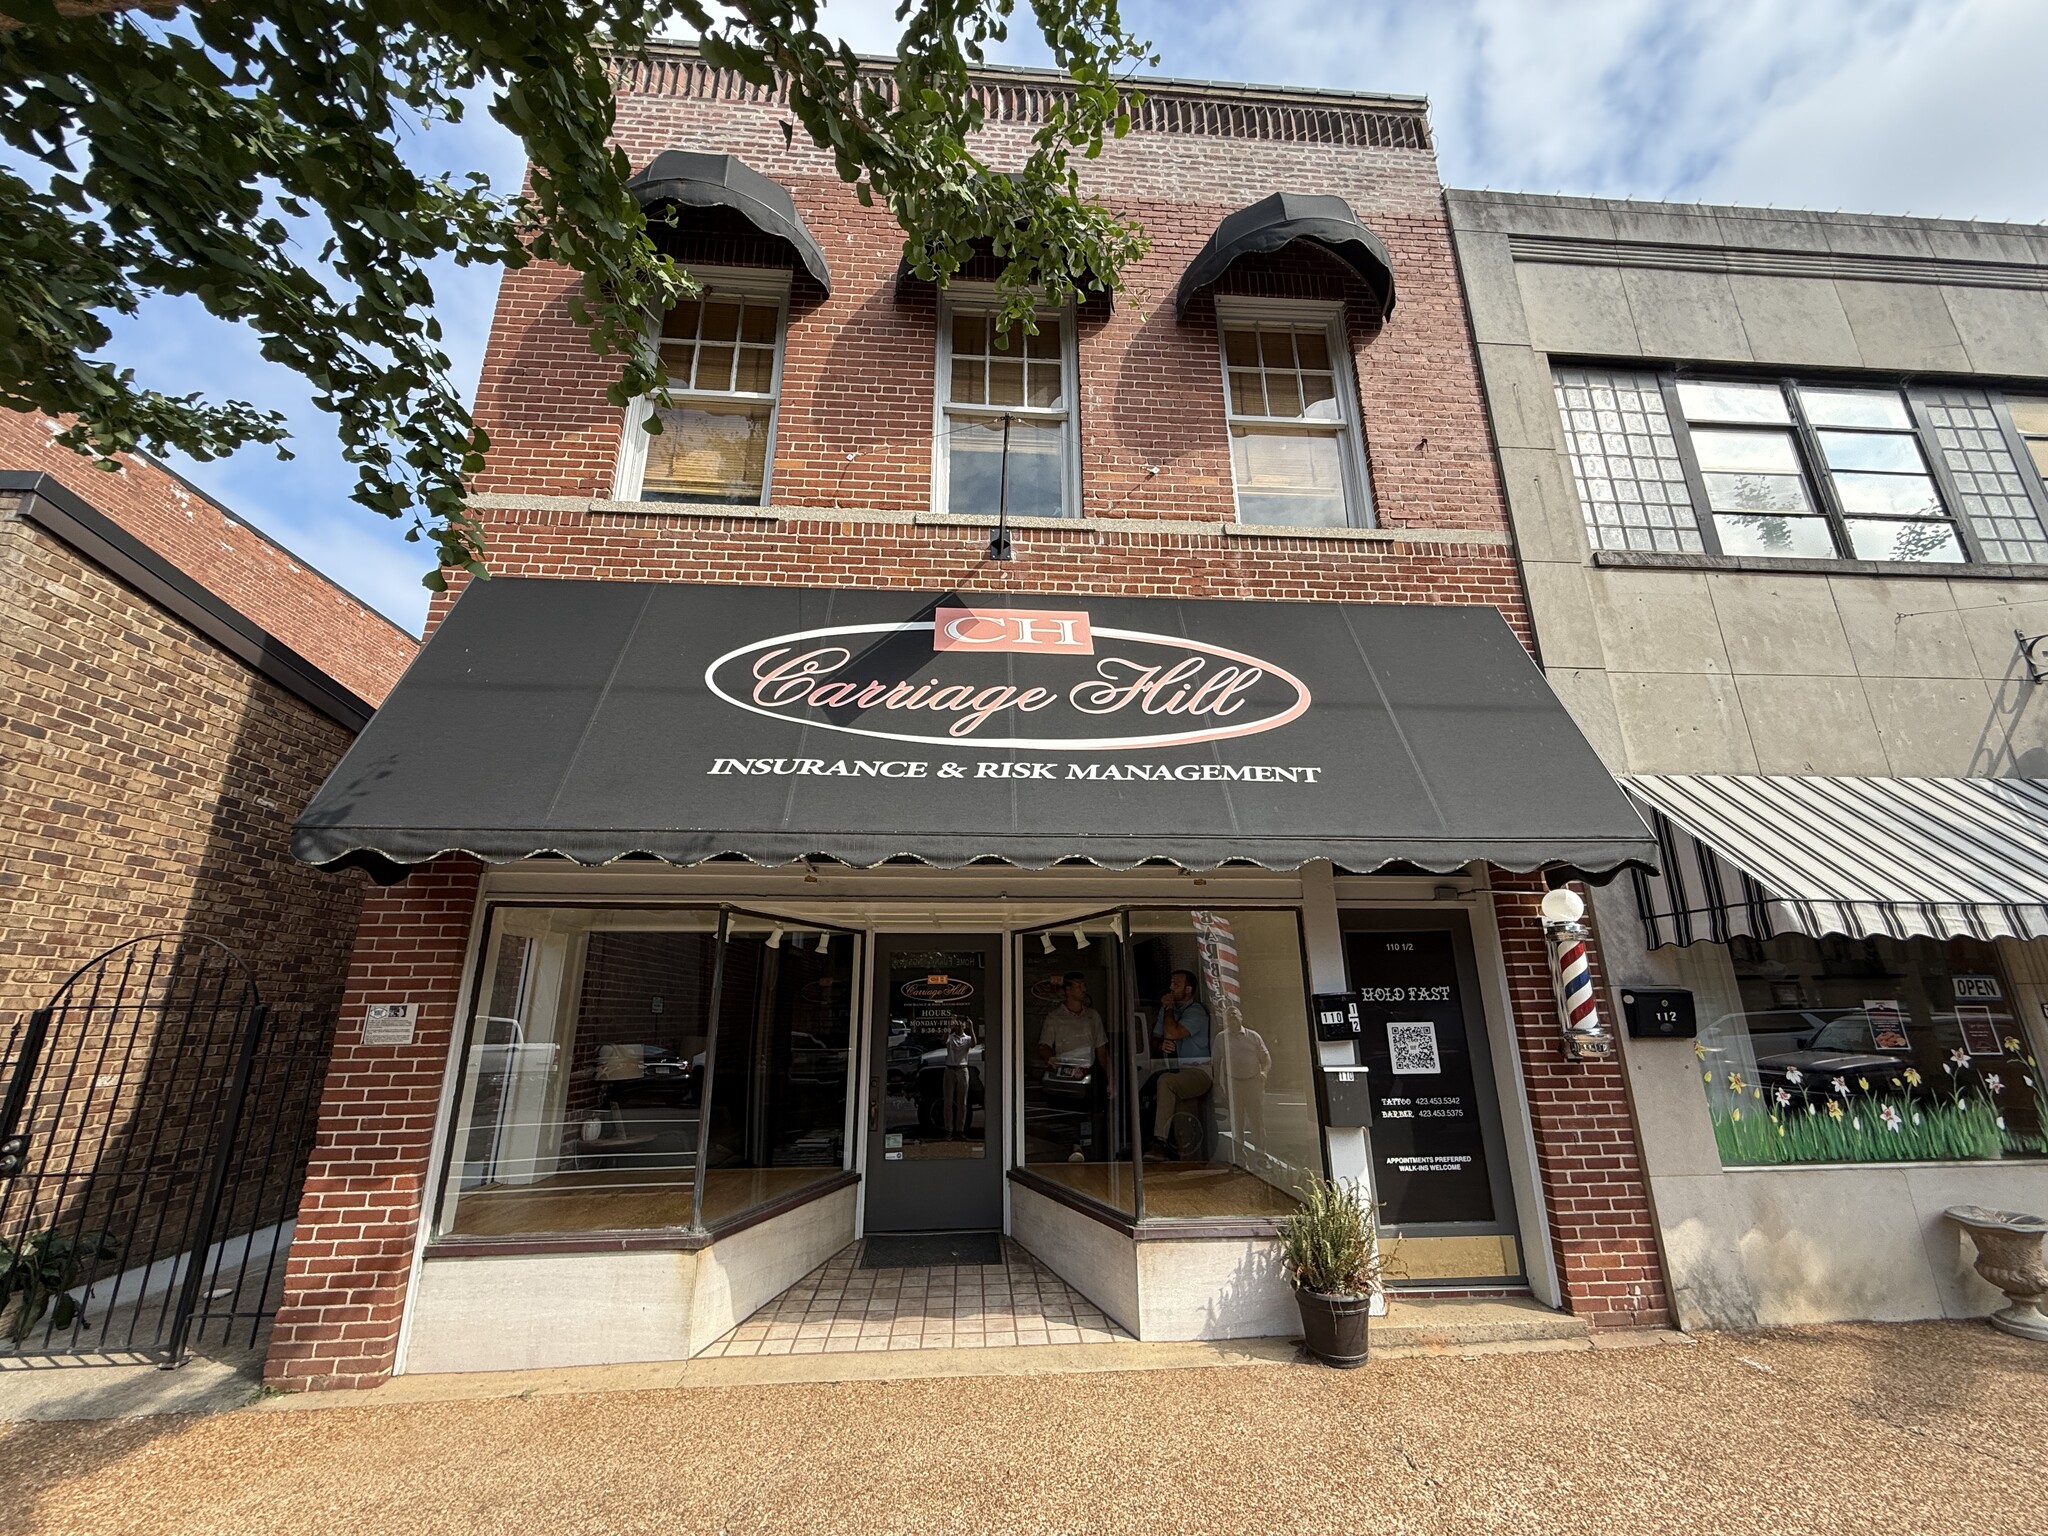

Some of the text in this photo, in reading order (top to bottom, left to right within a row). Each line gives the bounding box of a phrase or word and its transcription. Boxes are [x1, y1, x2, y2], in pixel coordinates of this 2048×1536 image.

[943, 616, 1085, 647] CH
[752, 647, 1263, 737] Carriage Hill
[706, 757, 1322, 785] INSURANCE & RISK MANAGEMENT
[1385, 943, 1415, 951] 110 1/2
[943, 984, 967, 995] Hill
[1957, 979, 1997, 996] OPEN
[1360, 985, 1450, 1002] HOLD FAST
[921, 1009, 952, 1017] HOURS
[1323, 1012, 1342, 1023] 110
[1655, 1011, 1677, 1022] 112
[1381, 1097, 1461, 1106] TATTOO 423.453.5342
[1381, 1109, 1464, 1119] BARBER 423.453.5375
[1386, 1155, 1472, 1165] APPOINTMENTS PREFERRED
[1398, 1163, 1462, 1172] WALK-INS WELCOME
